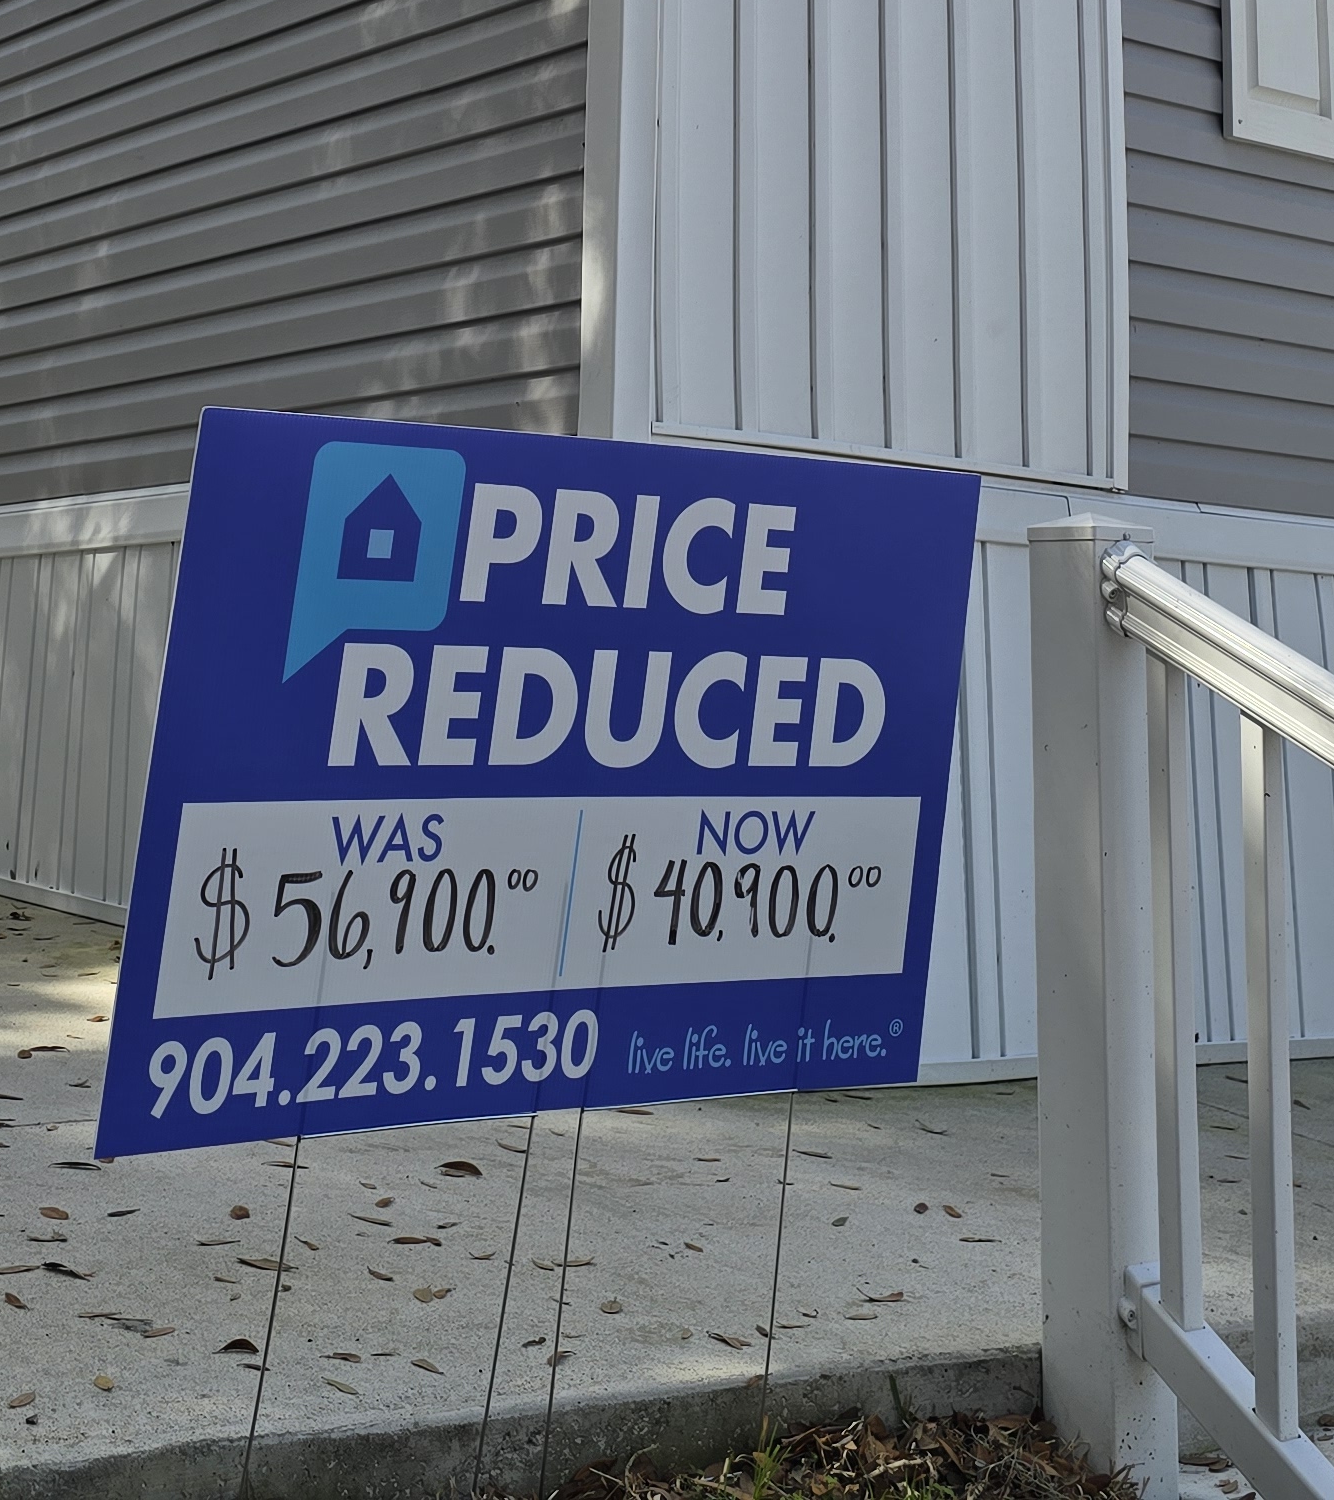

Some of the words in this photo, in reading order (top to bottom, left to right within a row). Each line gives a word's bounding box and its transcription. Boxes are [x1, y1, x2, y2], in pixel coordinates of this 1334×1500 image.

[459, 482, 797, 616] PRICE
[327, 642, 886, 769] REDUCED
[331, 812, 445, 866] WAS
[696, 808, 816, 857] NOW
[147, 1009, 599, 1119] 904.223.1530
[627, 1030, 675, 1074] live
[682, 1024, 732, 1070] life.
[742, 1023, 788, 1067] live
[796, 1026, 816, 1063] it
